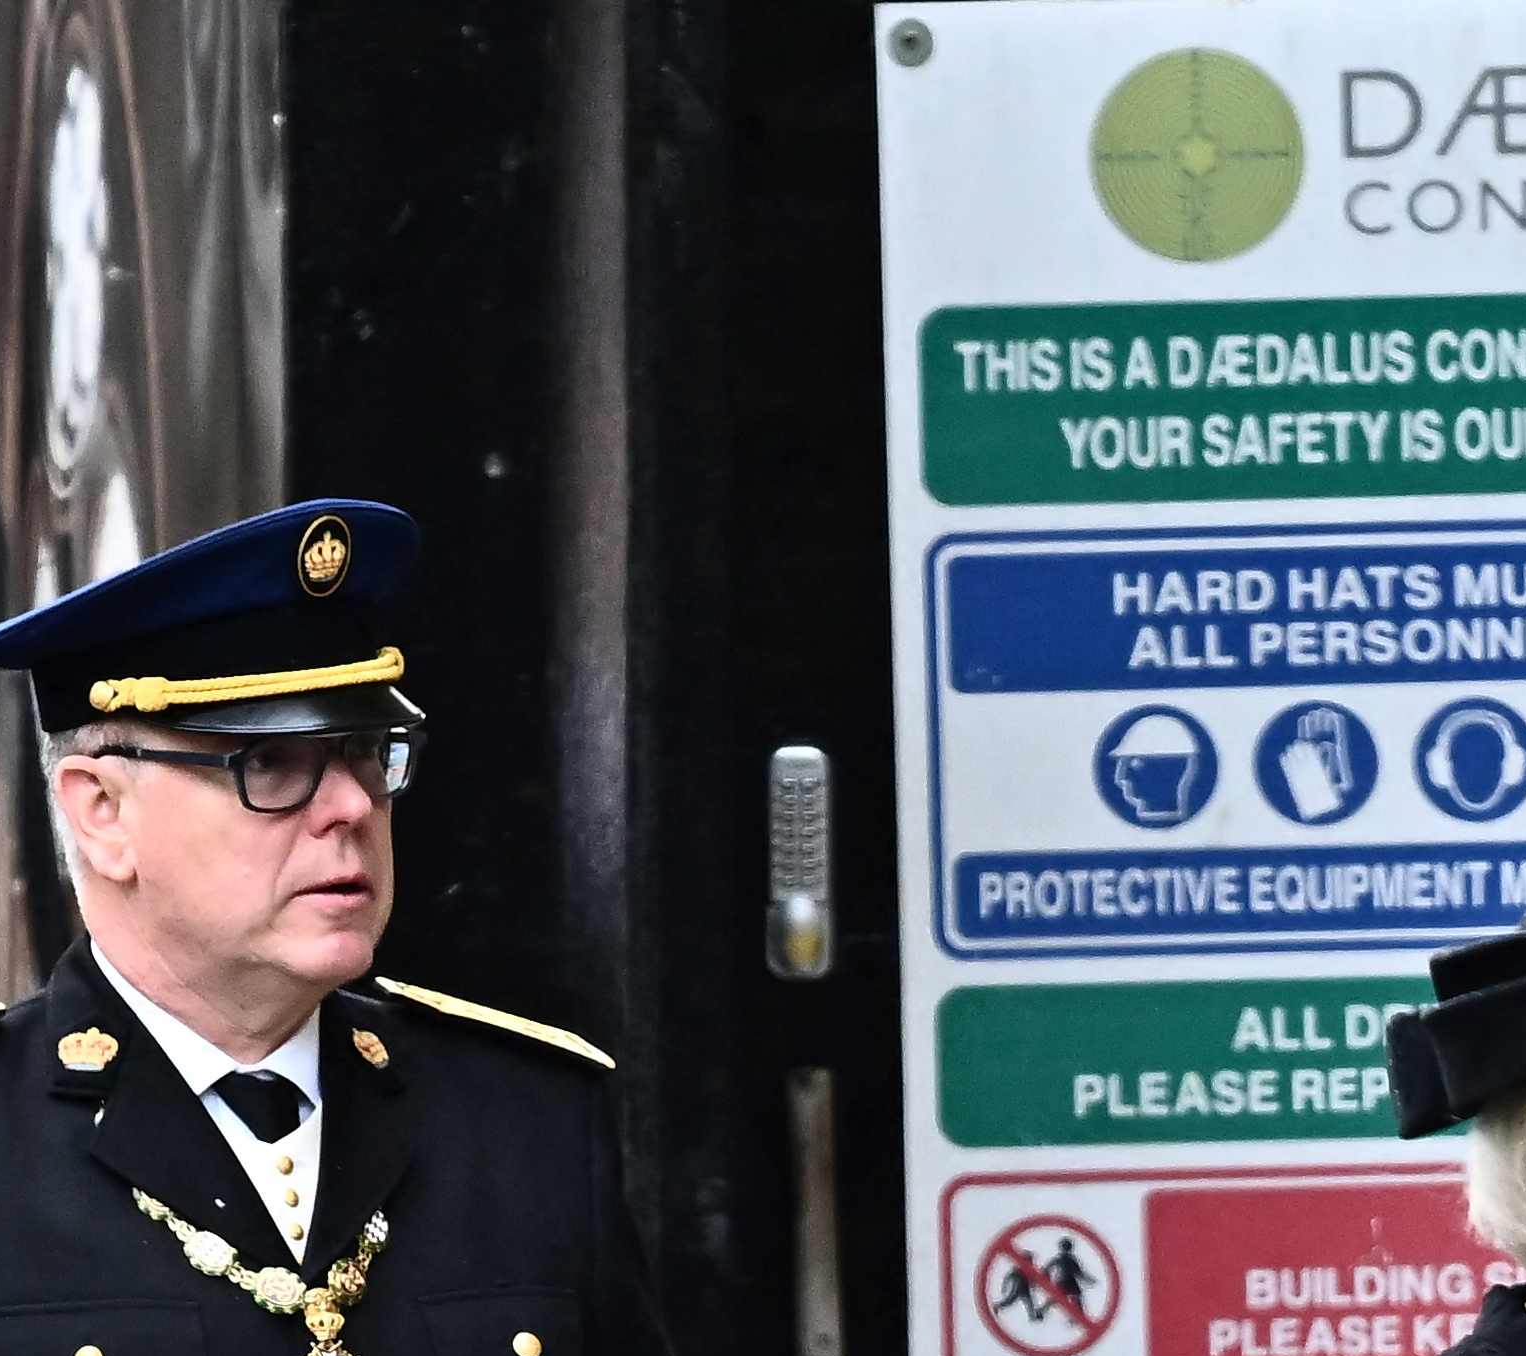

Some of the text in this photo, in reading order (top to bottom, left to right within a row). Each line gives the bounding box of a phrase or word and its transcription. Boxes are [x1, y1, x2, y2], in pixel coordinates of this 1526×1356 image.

[954, 337, 1063, 393] THIS
[1069, 335, 1116, 391] IS
[1124, 335, 1159, 390] A
[1168, 328, 1416, 389] DÆDALUS
[1060, 415, 1193, 471] YOUR
[1201, 409, 1390, 467] SAFETY
[1399, 407, 1445, 462] IS
[1113, 569, 1276, 616] HARD
[1288, 564, 1442, 610] HATS
[1128, 624, 1238, 669] ALL
[979, 865, 1242, 918] PROTECTIVE
[1249, 859, 1493, 914] EQUIPMENT
[1232, 1005, 1335, 1052] ALL
[1073, 1069, 1280, 1118] PLEASE
[1244, 1262, 1476, 1310] BUILDING
